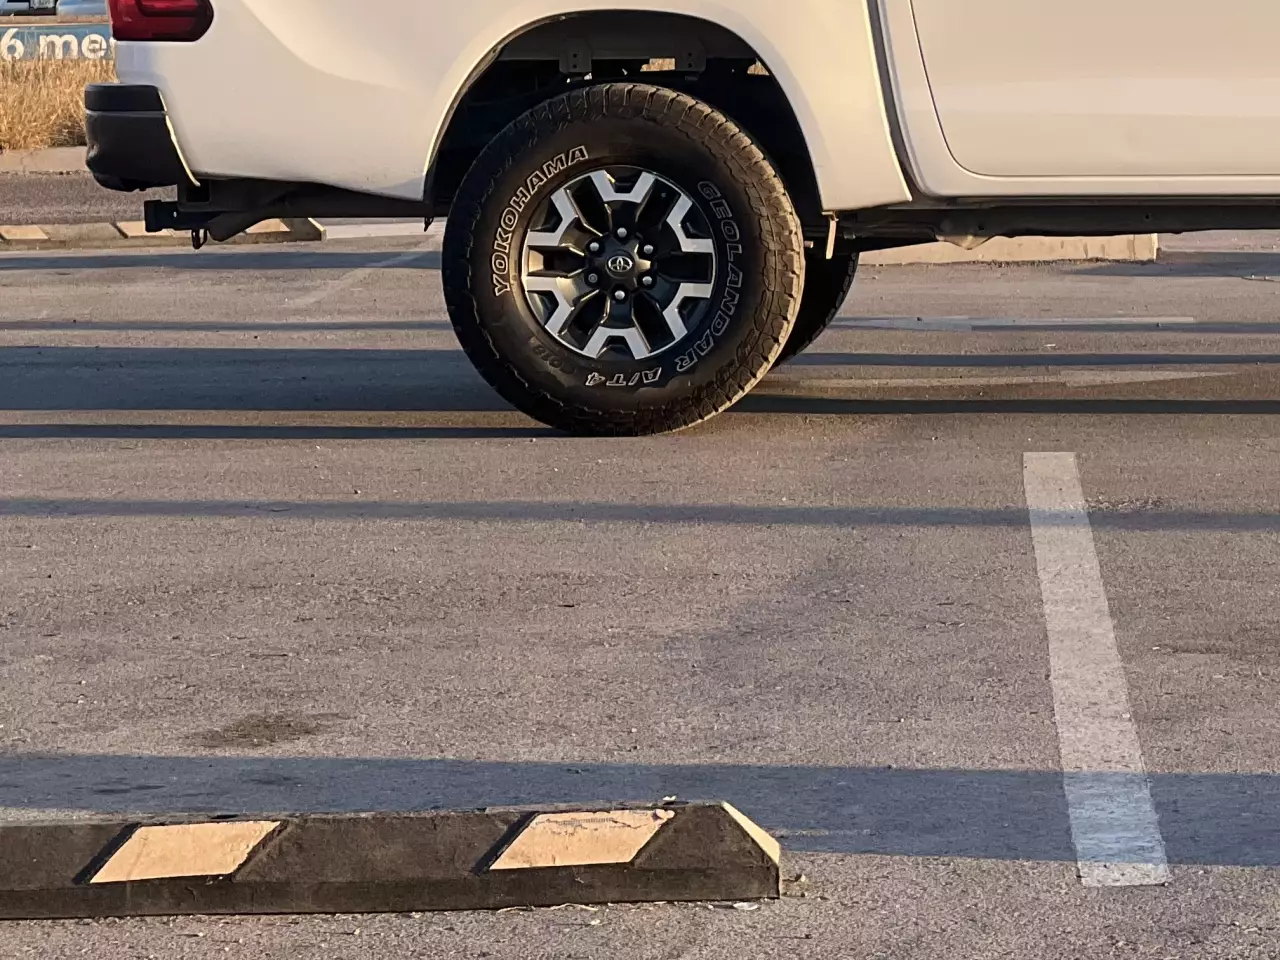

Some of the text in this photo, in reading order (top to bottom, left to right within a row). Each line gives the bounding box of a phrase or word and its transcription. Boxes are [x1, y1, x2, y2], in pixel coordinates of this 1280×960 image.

[39, 33, 116, 60] me
[491, 145, 589, 297] YOKOHAMA
[674, 180, 743, 373] GEOLANDAR
